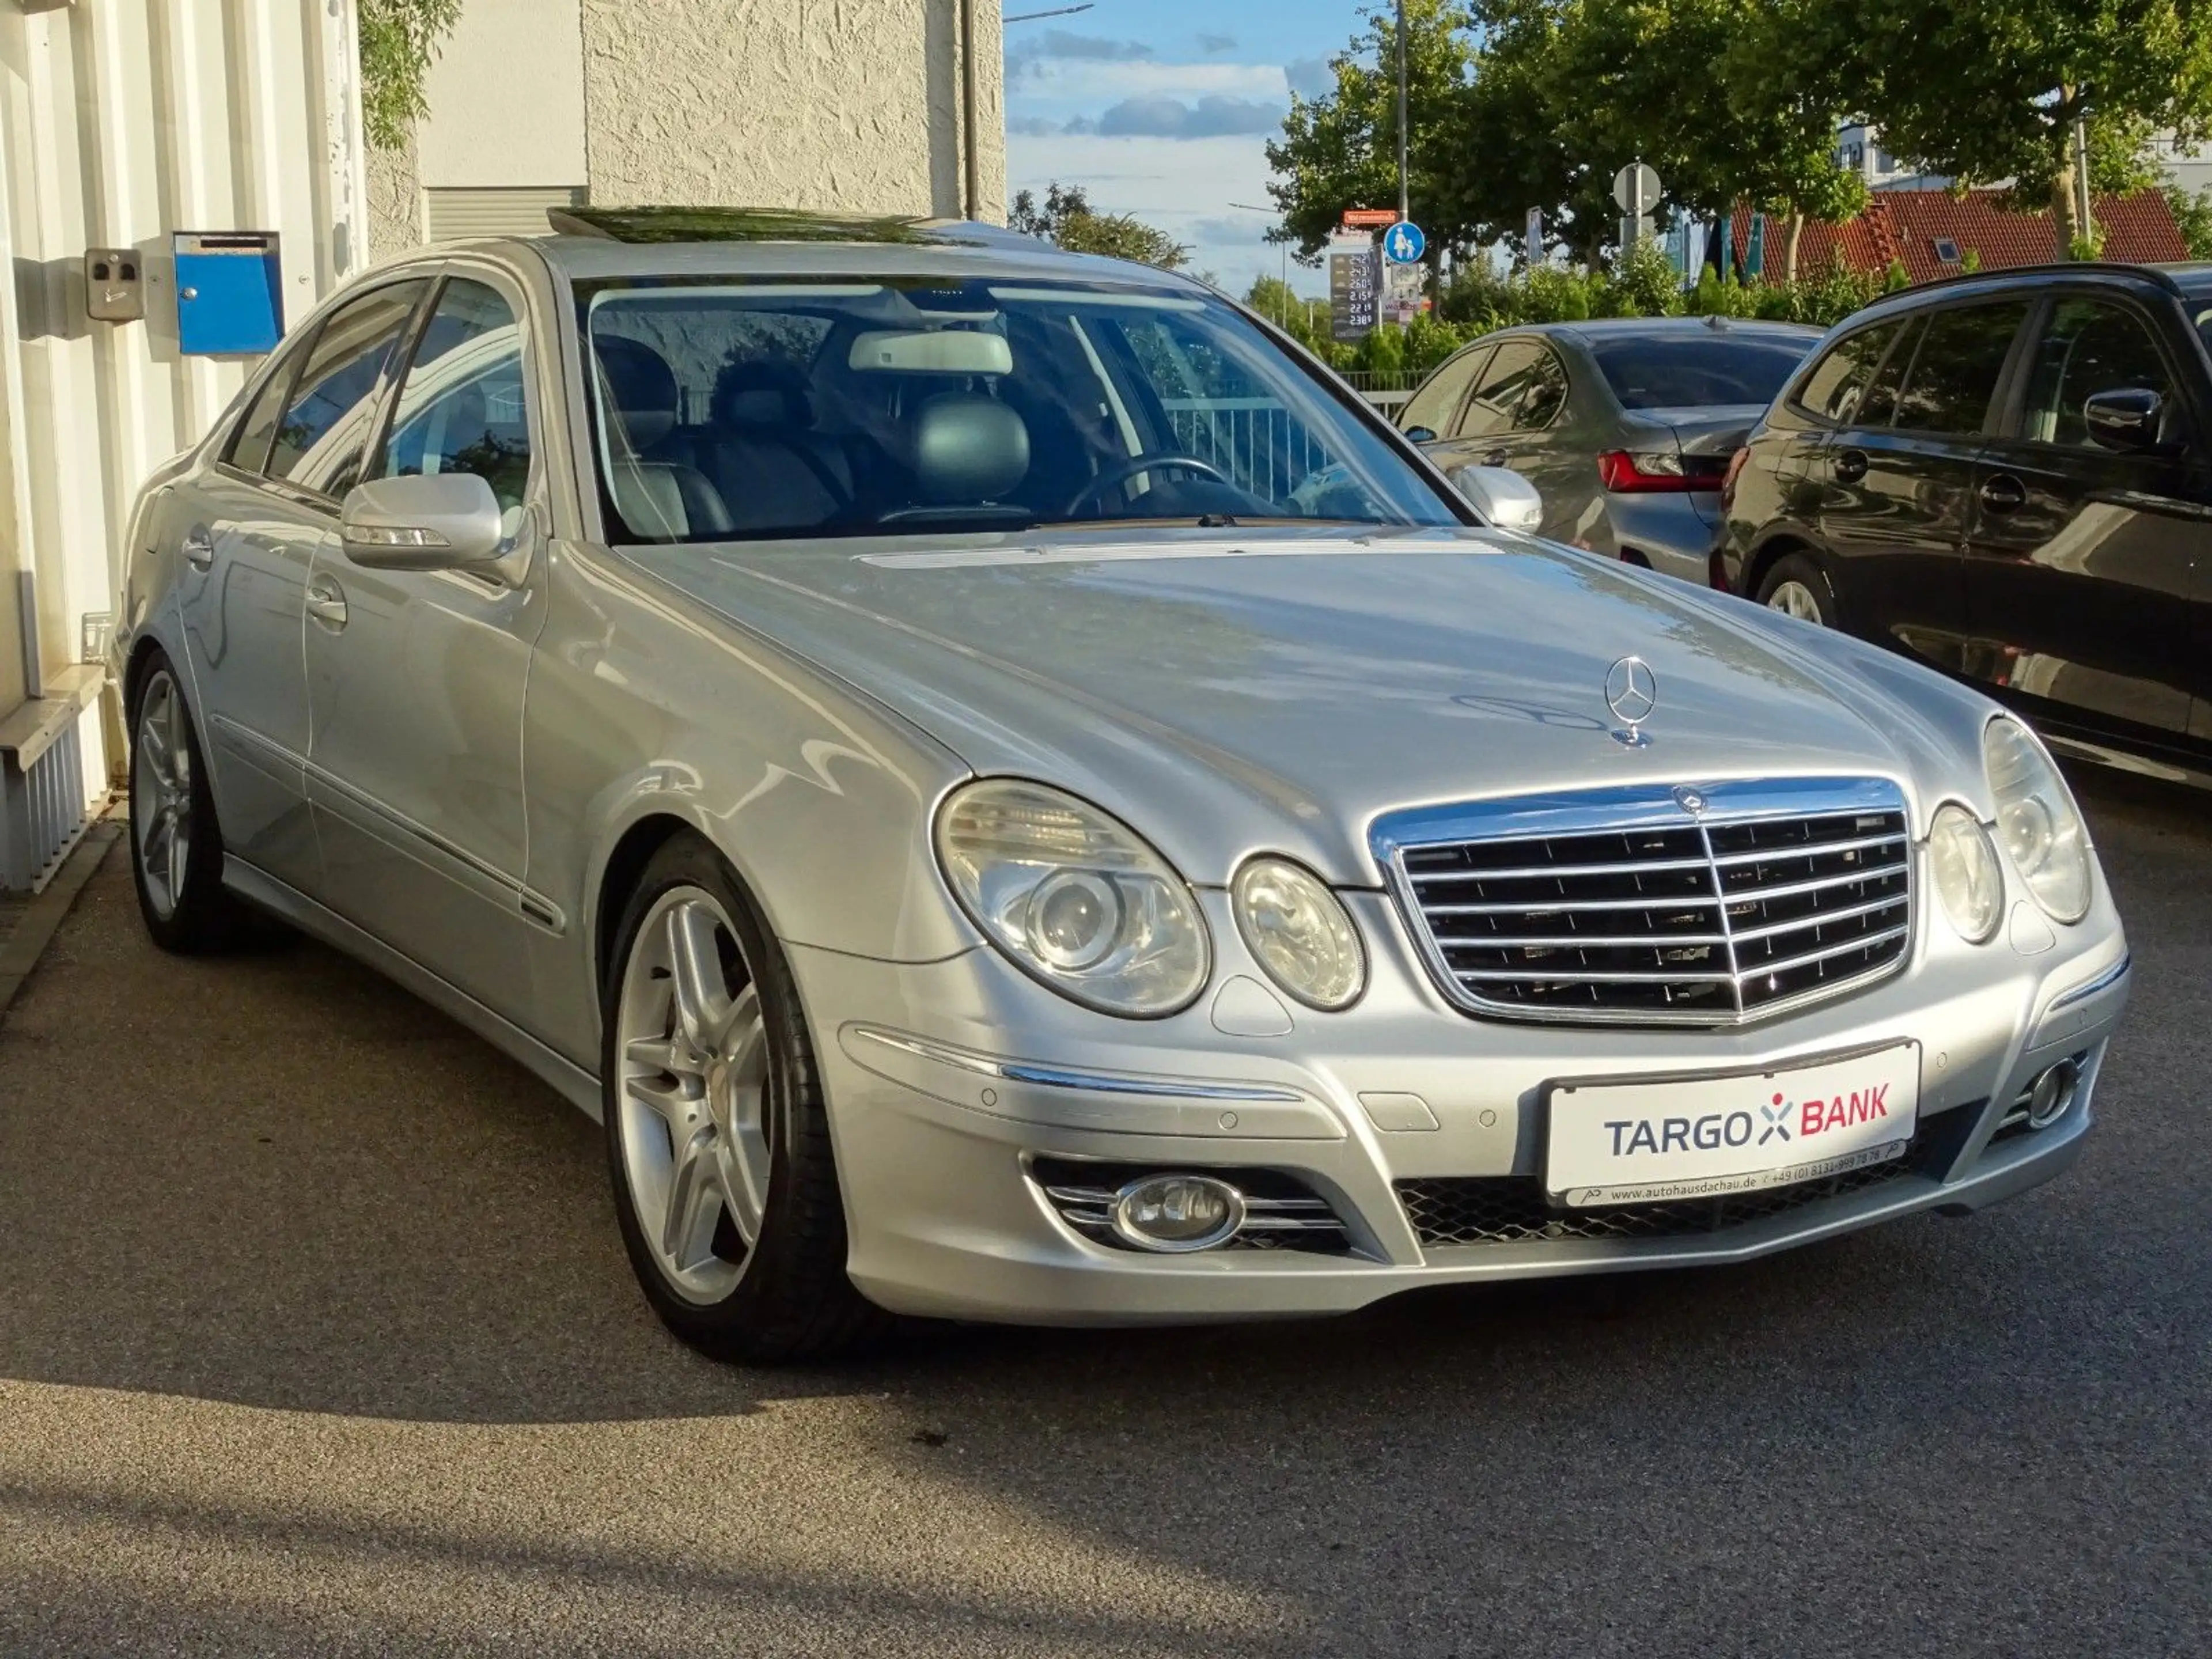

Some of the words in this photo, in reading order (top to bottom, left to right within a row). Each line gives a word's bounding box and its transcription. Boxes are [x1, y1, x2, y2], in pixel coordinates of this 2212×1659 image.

[1604, 1111, 1752, 1156] TARGO
[1800, 1082, 1889, 1136] BANK
[1611, 1176, 1757, 1200] www.autohausdachau.de
